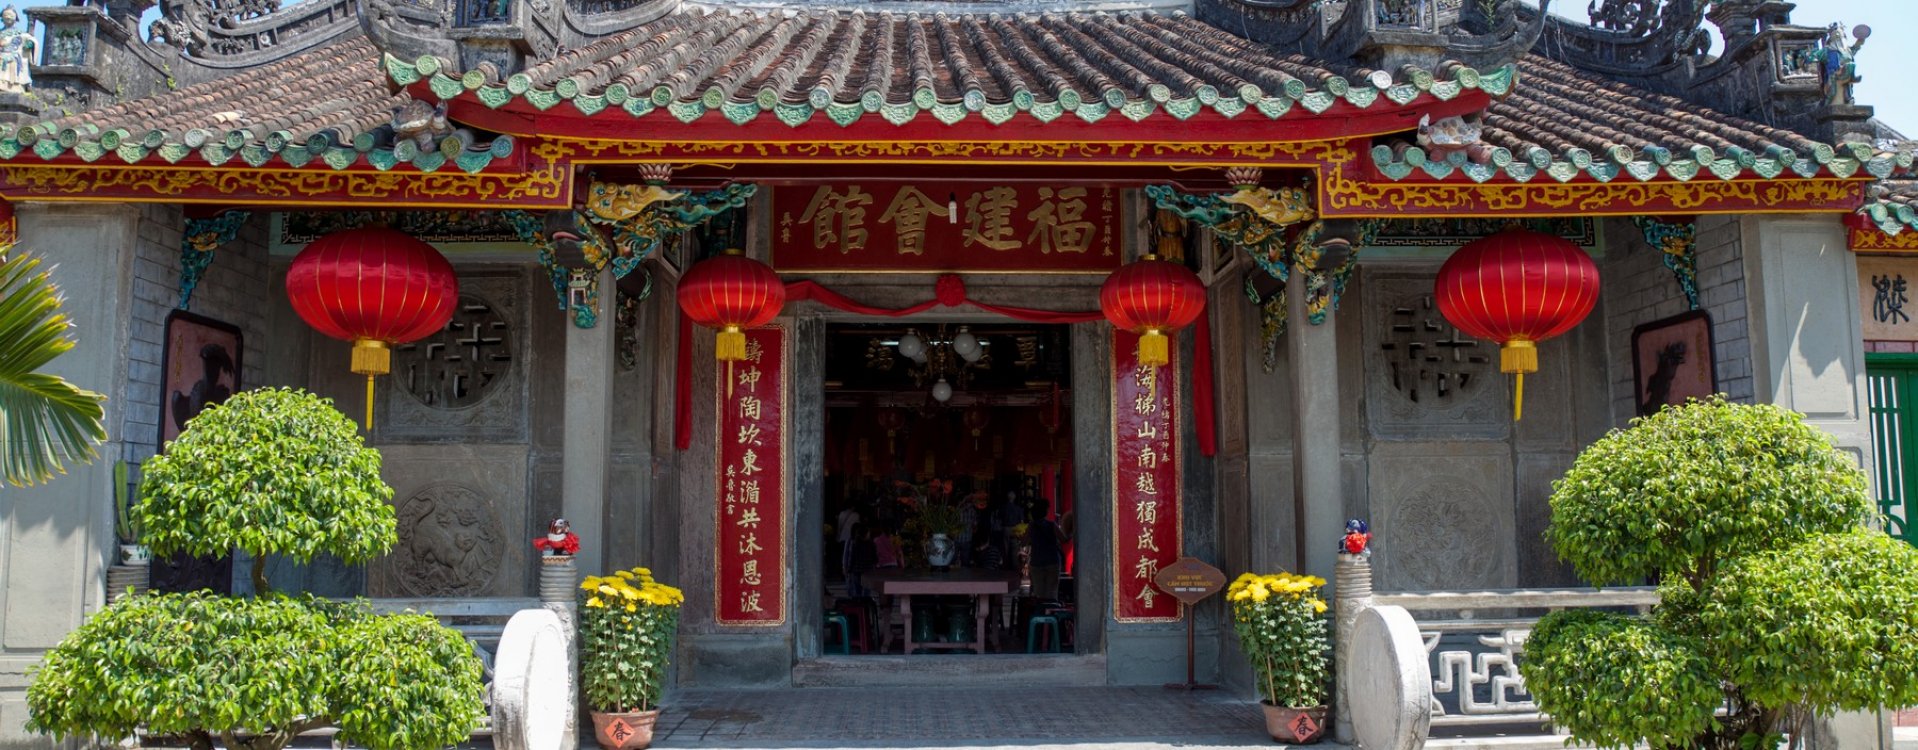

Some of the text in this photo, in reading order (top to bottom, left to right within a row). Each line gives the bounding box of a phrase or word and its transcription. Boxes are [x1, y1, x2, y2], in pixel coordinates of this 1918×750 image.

[798, 185, 1097, 256] 福建會館
[1132, 342, 1160, 610] 海梯山南越獨成都會
[612, 721, 631, 741] 春
[1295, 715, 1313, 736] 春
